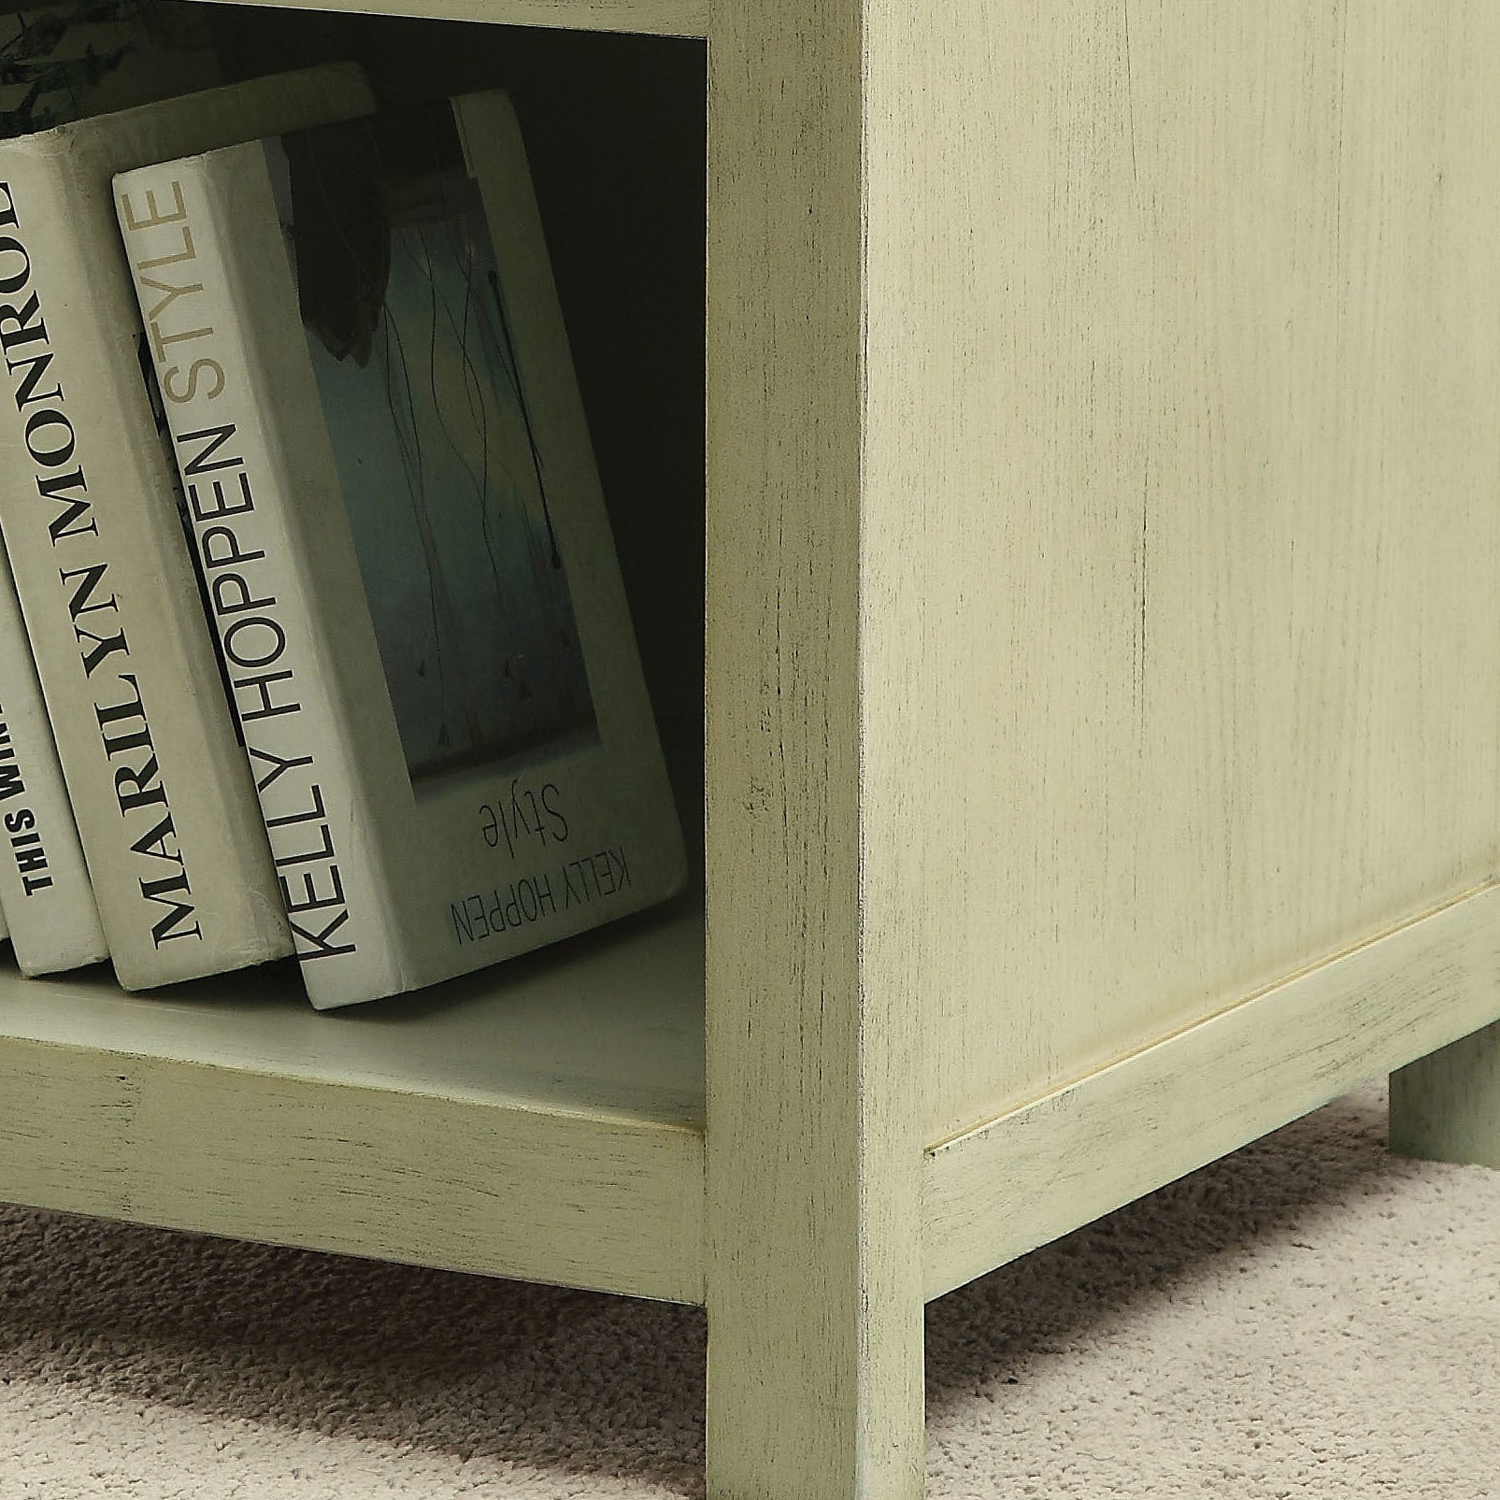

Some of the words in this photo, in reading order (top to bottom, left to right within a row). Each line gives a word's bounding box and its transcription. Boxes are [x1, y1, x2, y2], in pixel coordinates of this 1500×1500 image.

[122, 180, 227, 405] STYLE
[176, 422, 302, 723] HOPPEN
[59, 562, 203, 950] MARILYN
[478, 779, 569, 859] Style
[4, 806, 54, 898] THIS
[248, 746, 357, 963] KELLY
[450, 873, 556, 945] HOPPEN
[562, 846, 632, 908] KELLY
